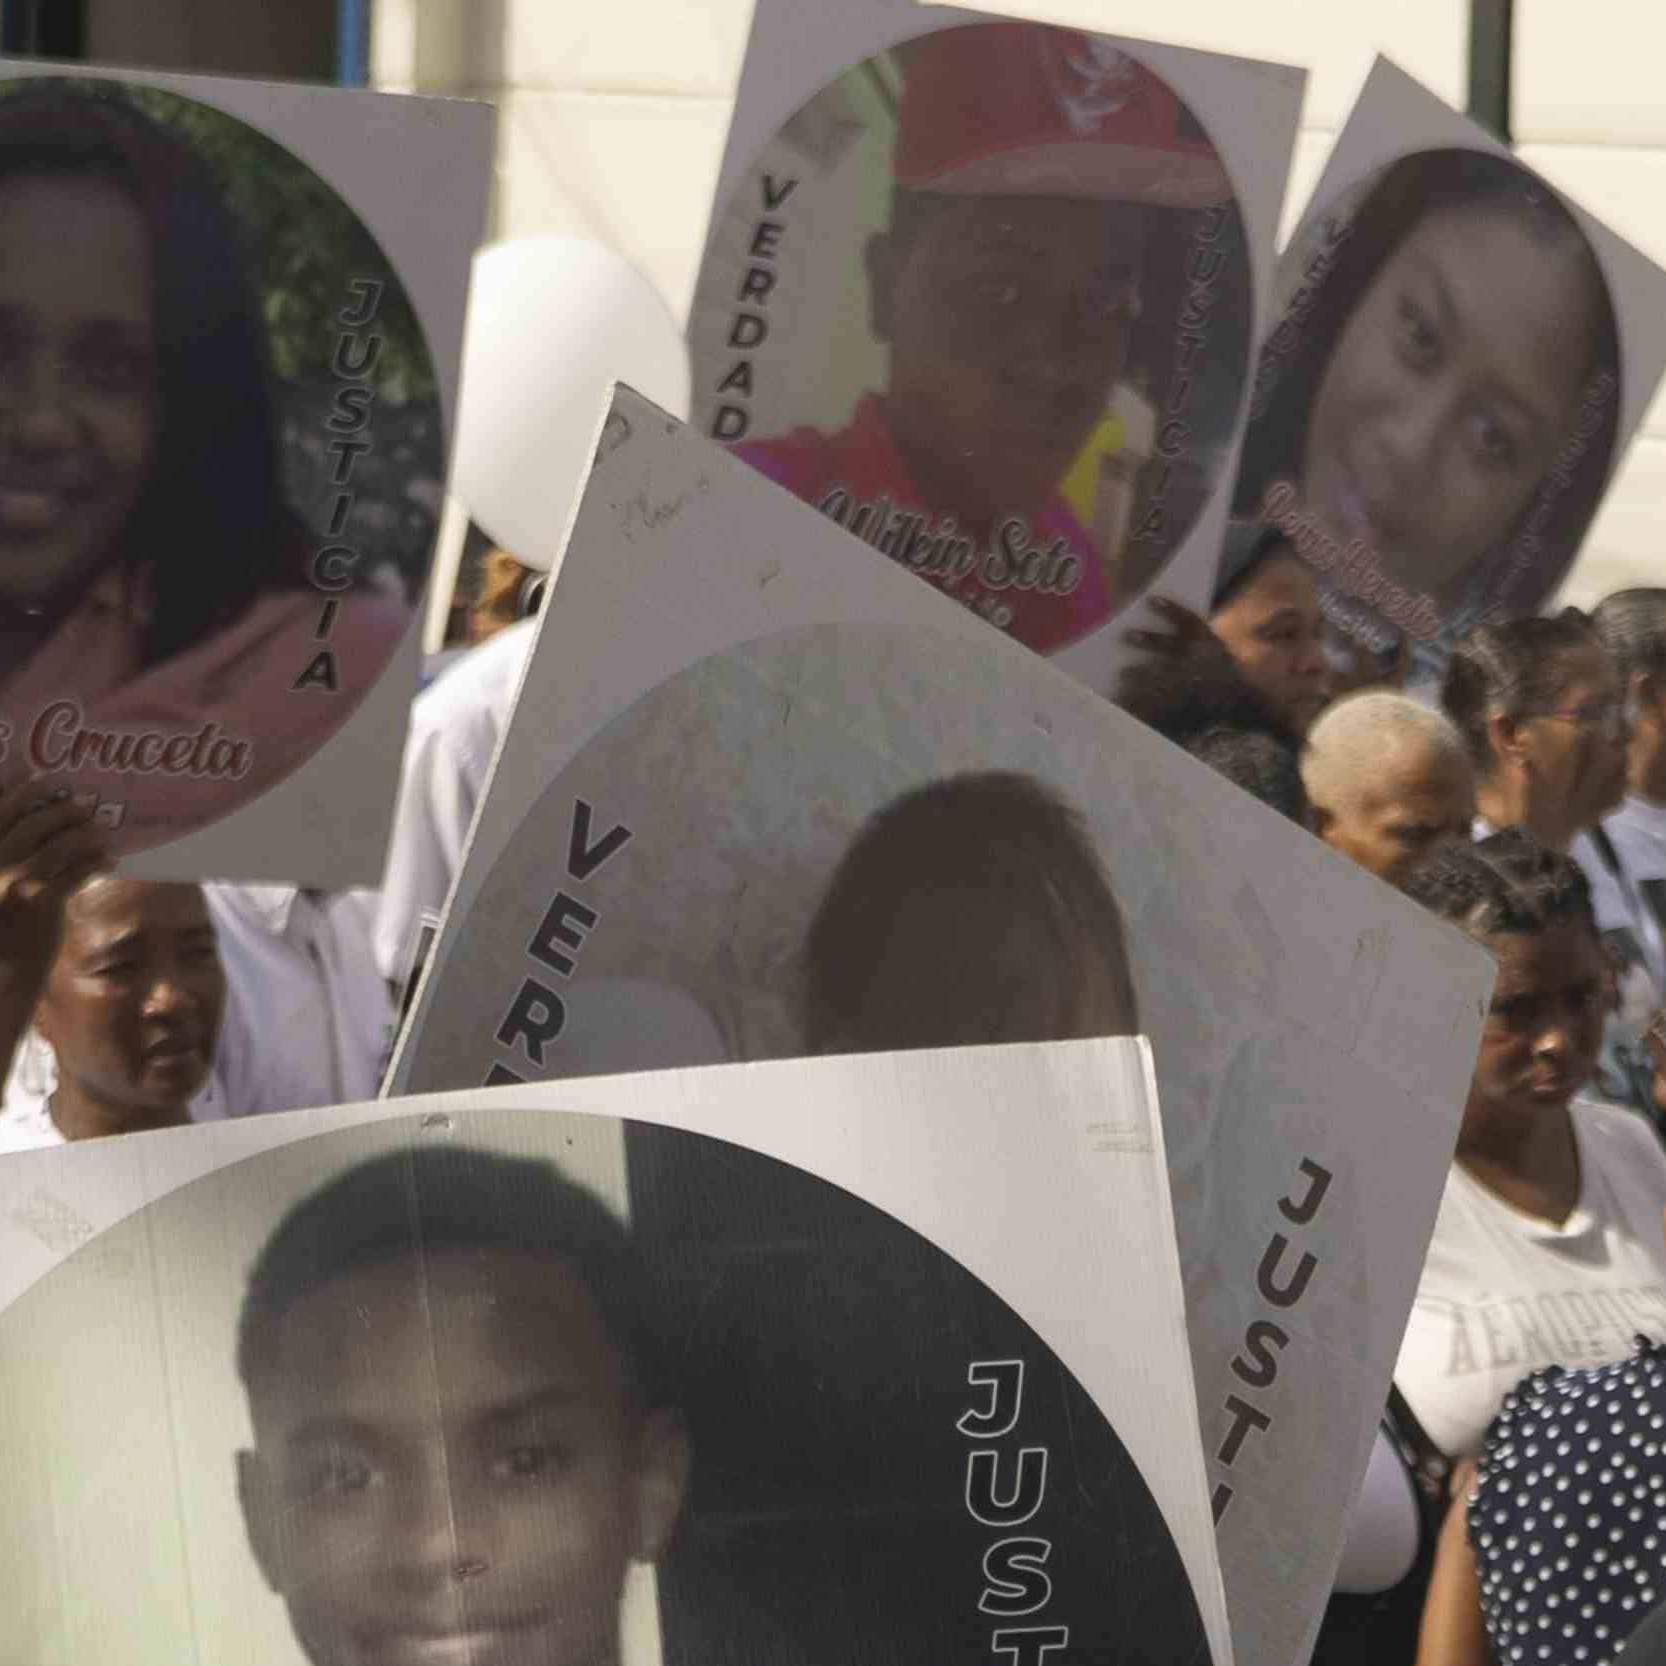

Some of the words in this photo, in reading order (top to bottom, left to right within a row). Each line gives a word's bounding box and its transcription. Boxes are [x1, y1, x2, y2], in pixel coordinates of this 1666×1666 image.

[708, 172, 798, 443] VERDAD
[1131, 202, 1228, 545] JUSTICIA
[289, 278, 384, 694] JUSTICIA
[27, 698, 253, 784] Cruceta
[483, 798, 632, 1086] VER
[1207, 1155, 1333, 1528] JUSTI
